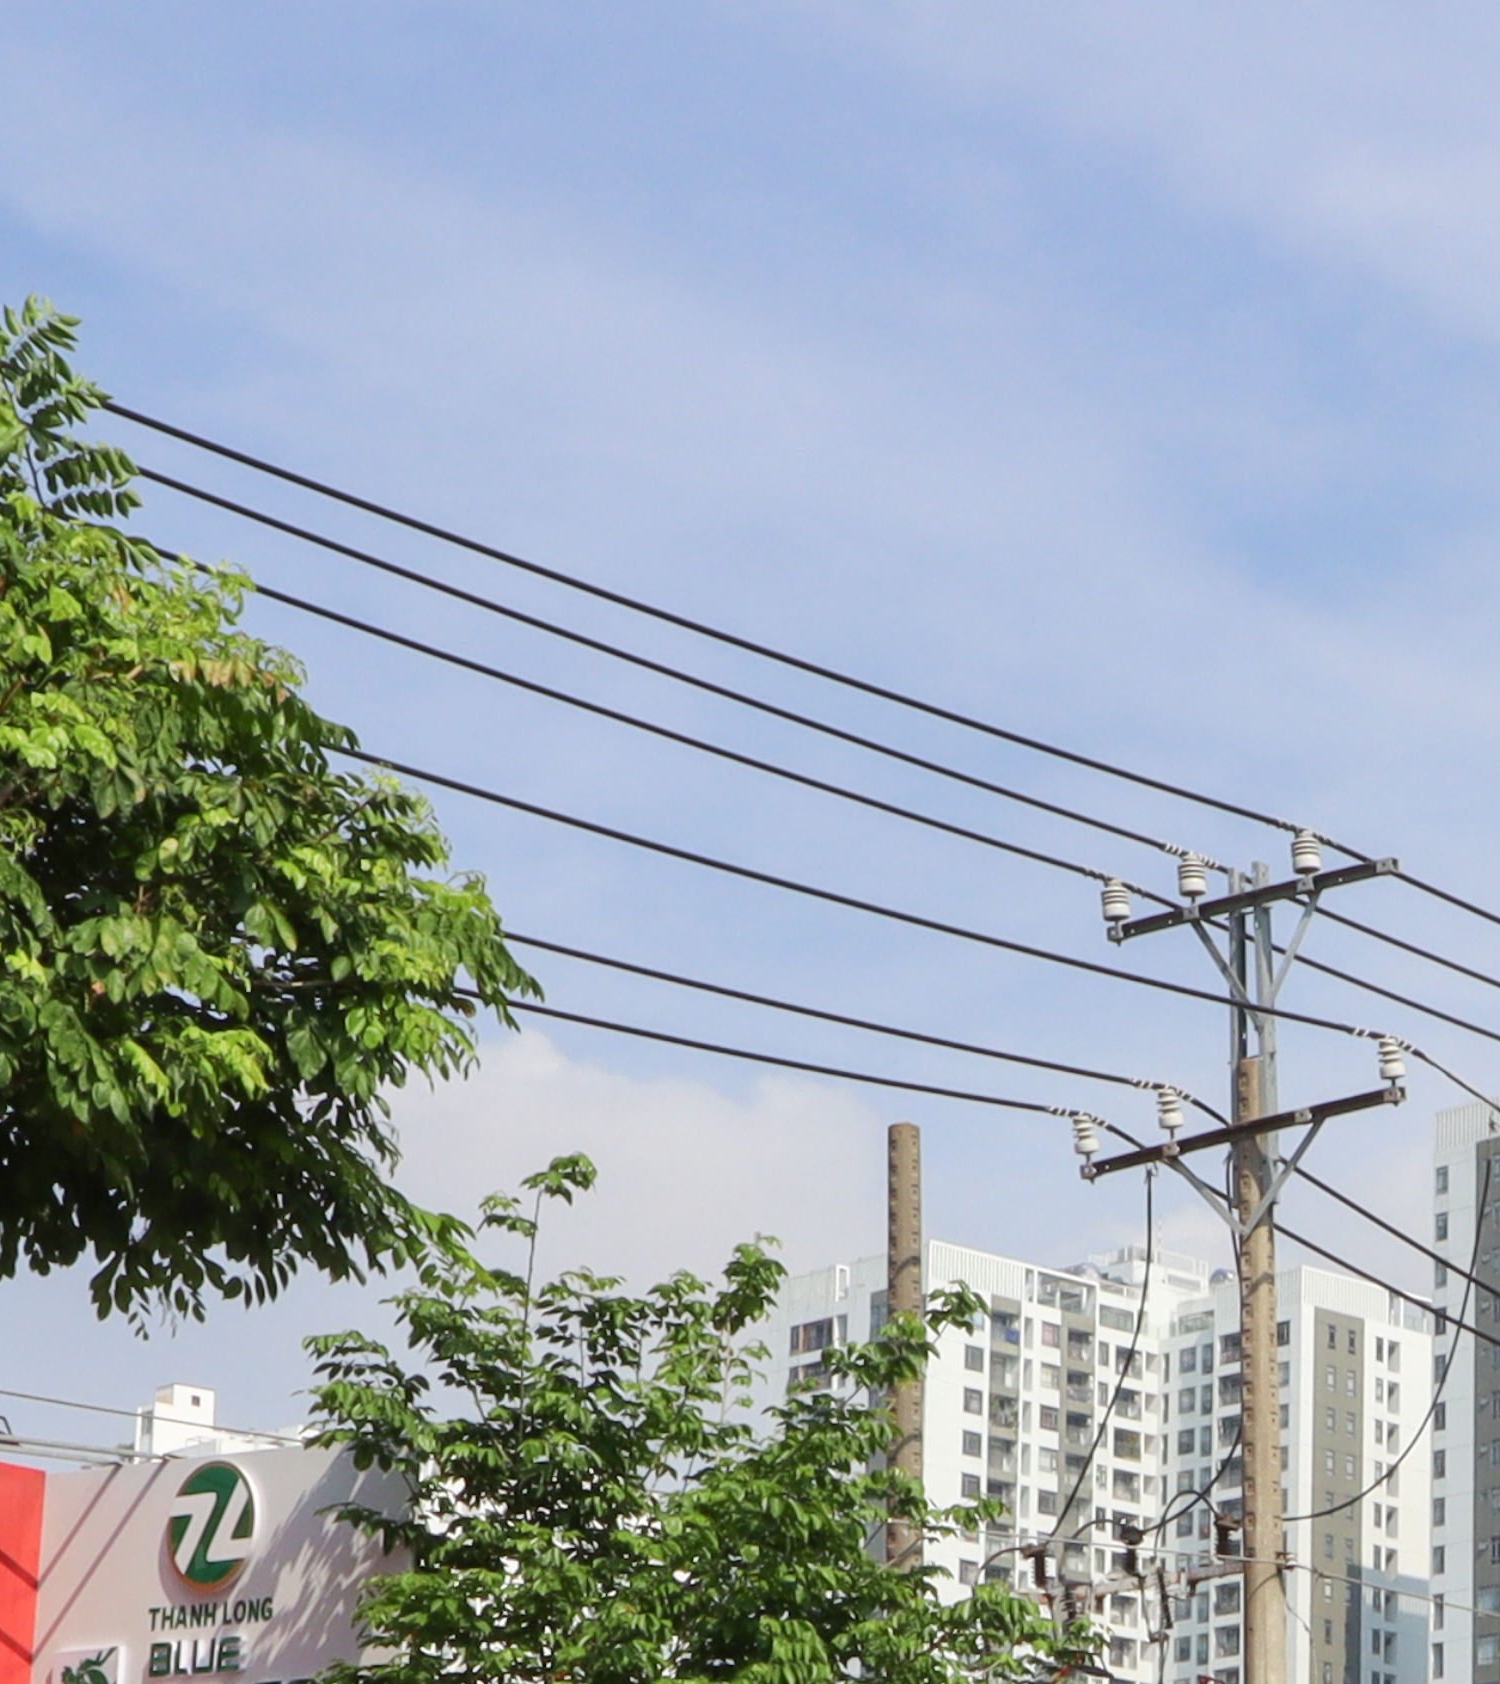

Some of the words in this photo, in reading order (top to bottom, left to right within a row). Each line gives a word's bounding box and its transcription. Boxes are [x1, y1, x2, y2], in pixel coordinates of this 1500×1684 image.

[149, 1603, 216, 1631] THANH
[223, 1597, 273, 1625] LONG
[149, 1636, 242, 1677] BLUE
